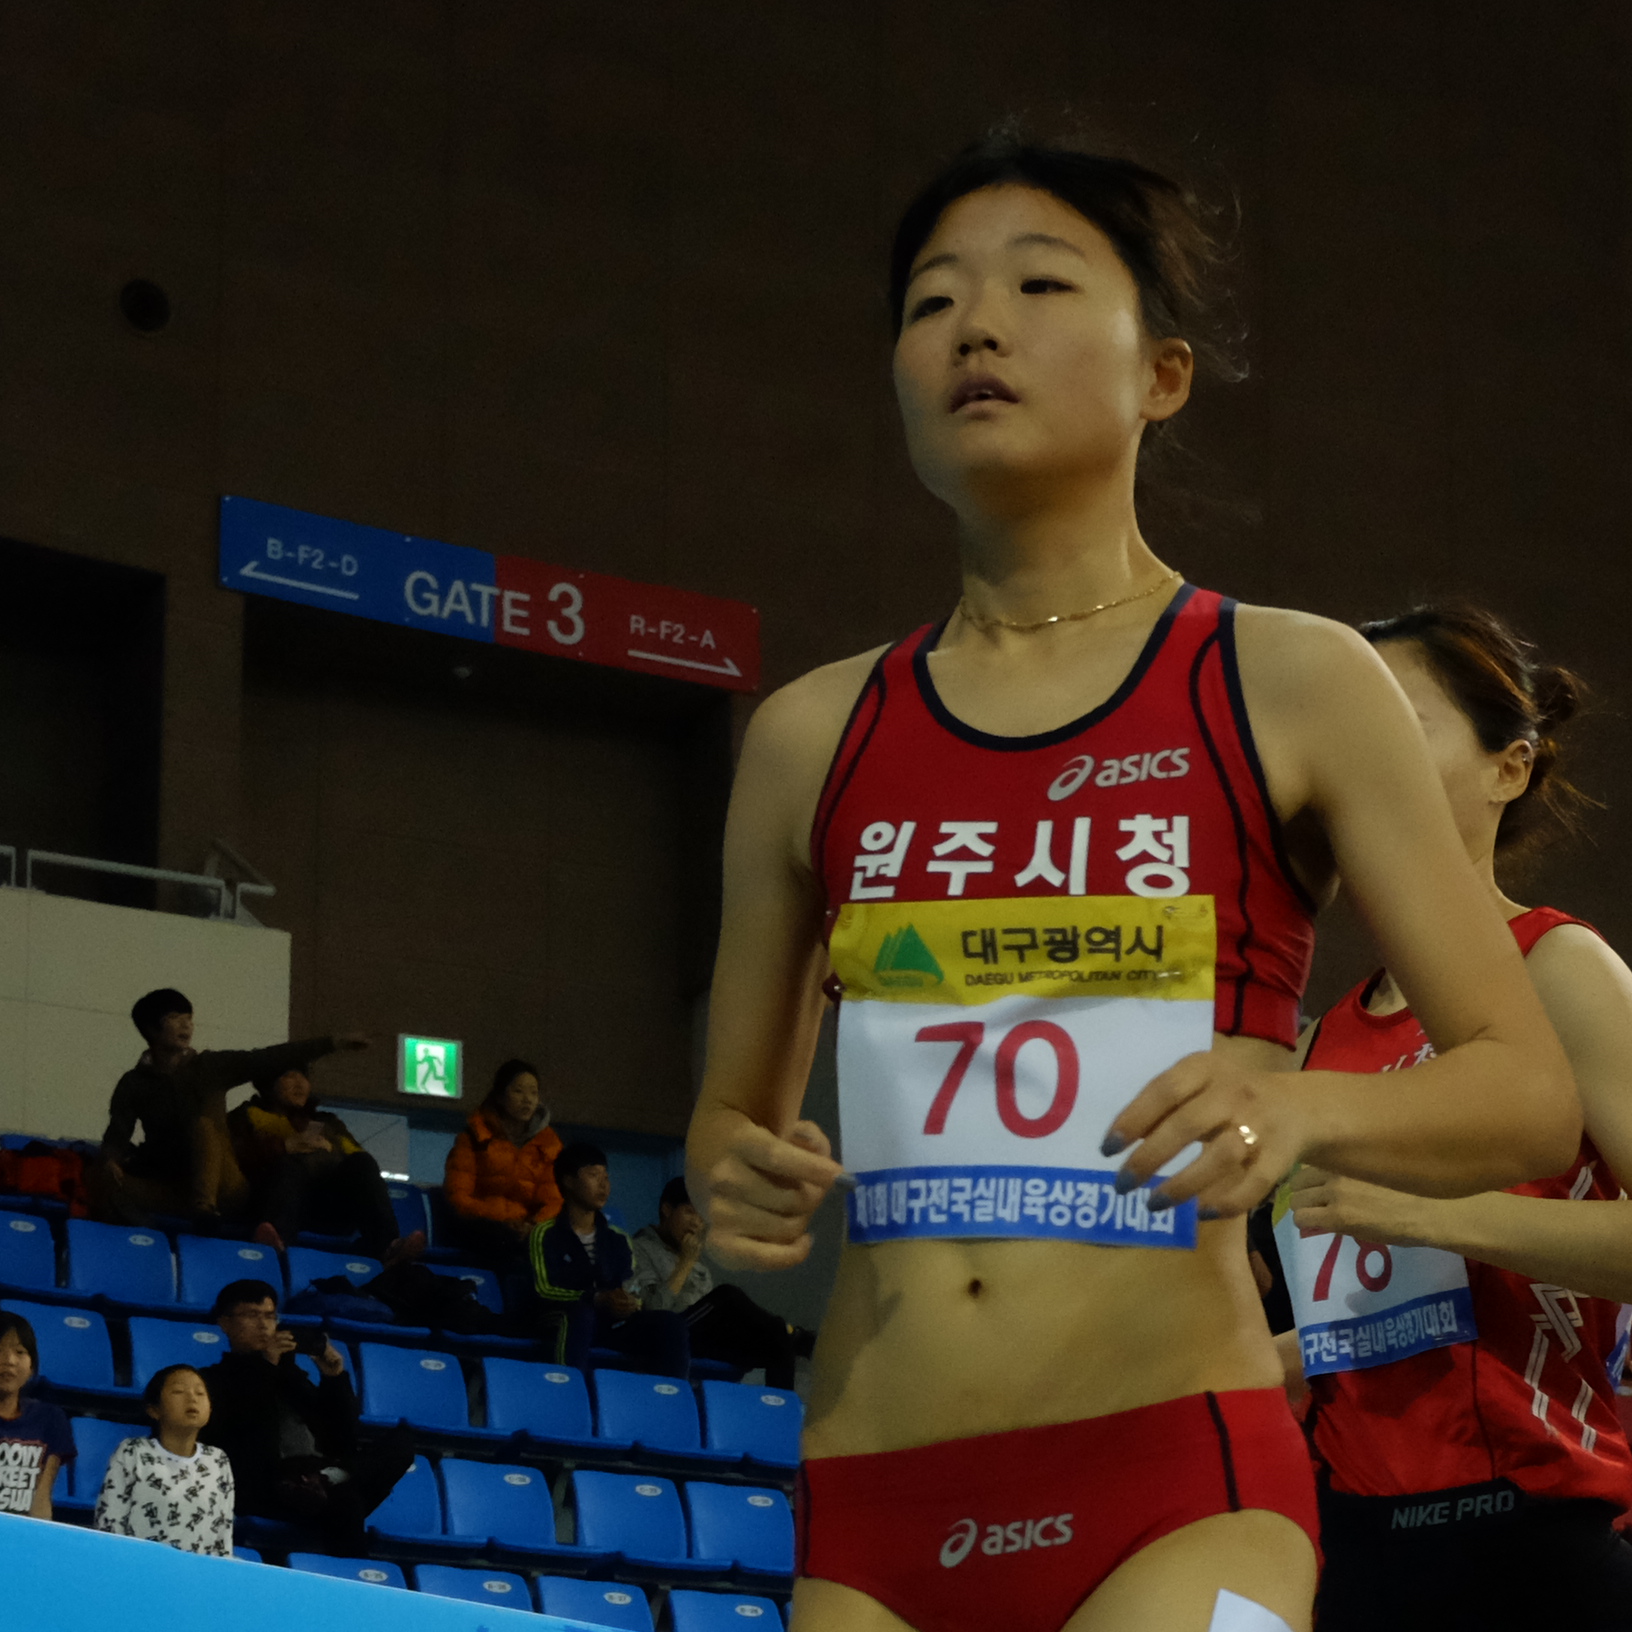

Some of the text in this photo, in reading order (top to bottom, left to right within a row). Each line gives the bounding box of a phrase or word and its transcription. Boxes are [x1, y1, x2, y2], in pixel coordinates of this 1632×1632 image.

[266, 537, 359, 577] B-F2-D
[404, 570, 586, 645] GATE 3
[629, 615, 717, 651] R-F2-A
[1094, 747, 1190, 788] asics
[848, 813, 1191, 901] 원주시청
[960, 924, 1165, 965] 대구광역시
[965, 971, 1015, 987] DAEGU
[914, 1018, 1081, 1138] 70
[1301, 1299, 1459, 1368] 구전국실내육상경기대회
[1390, 1490, 1516, 1531] NIKE PRO
[980, 1512, 1074, 1557] asics
